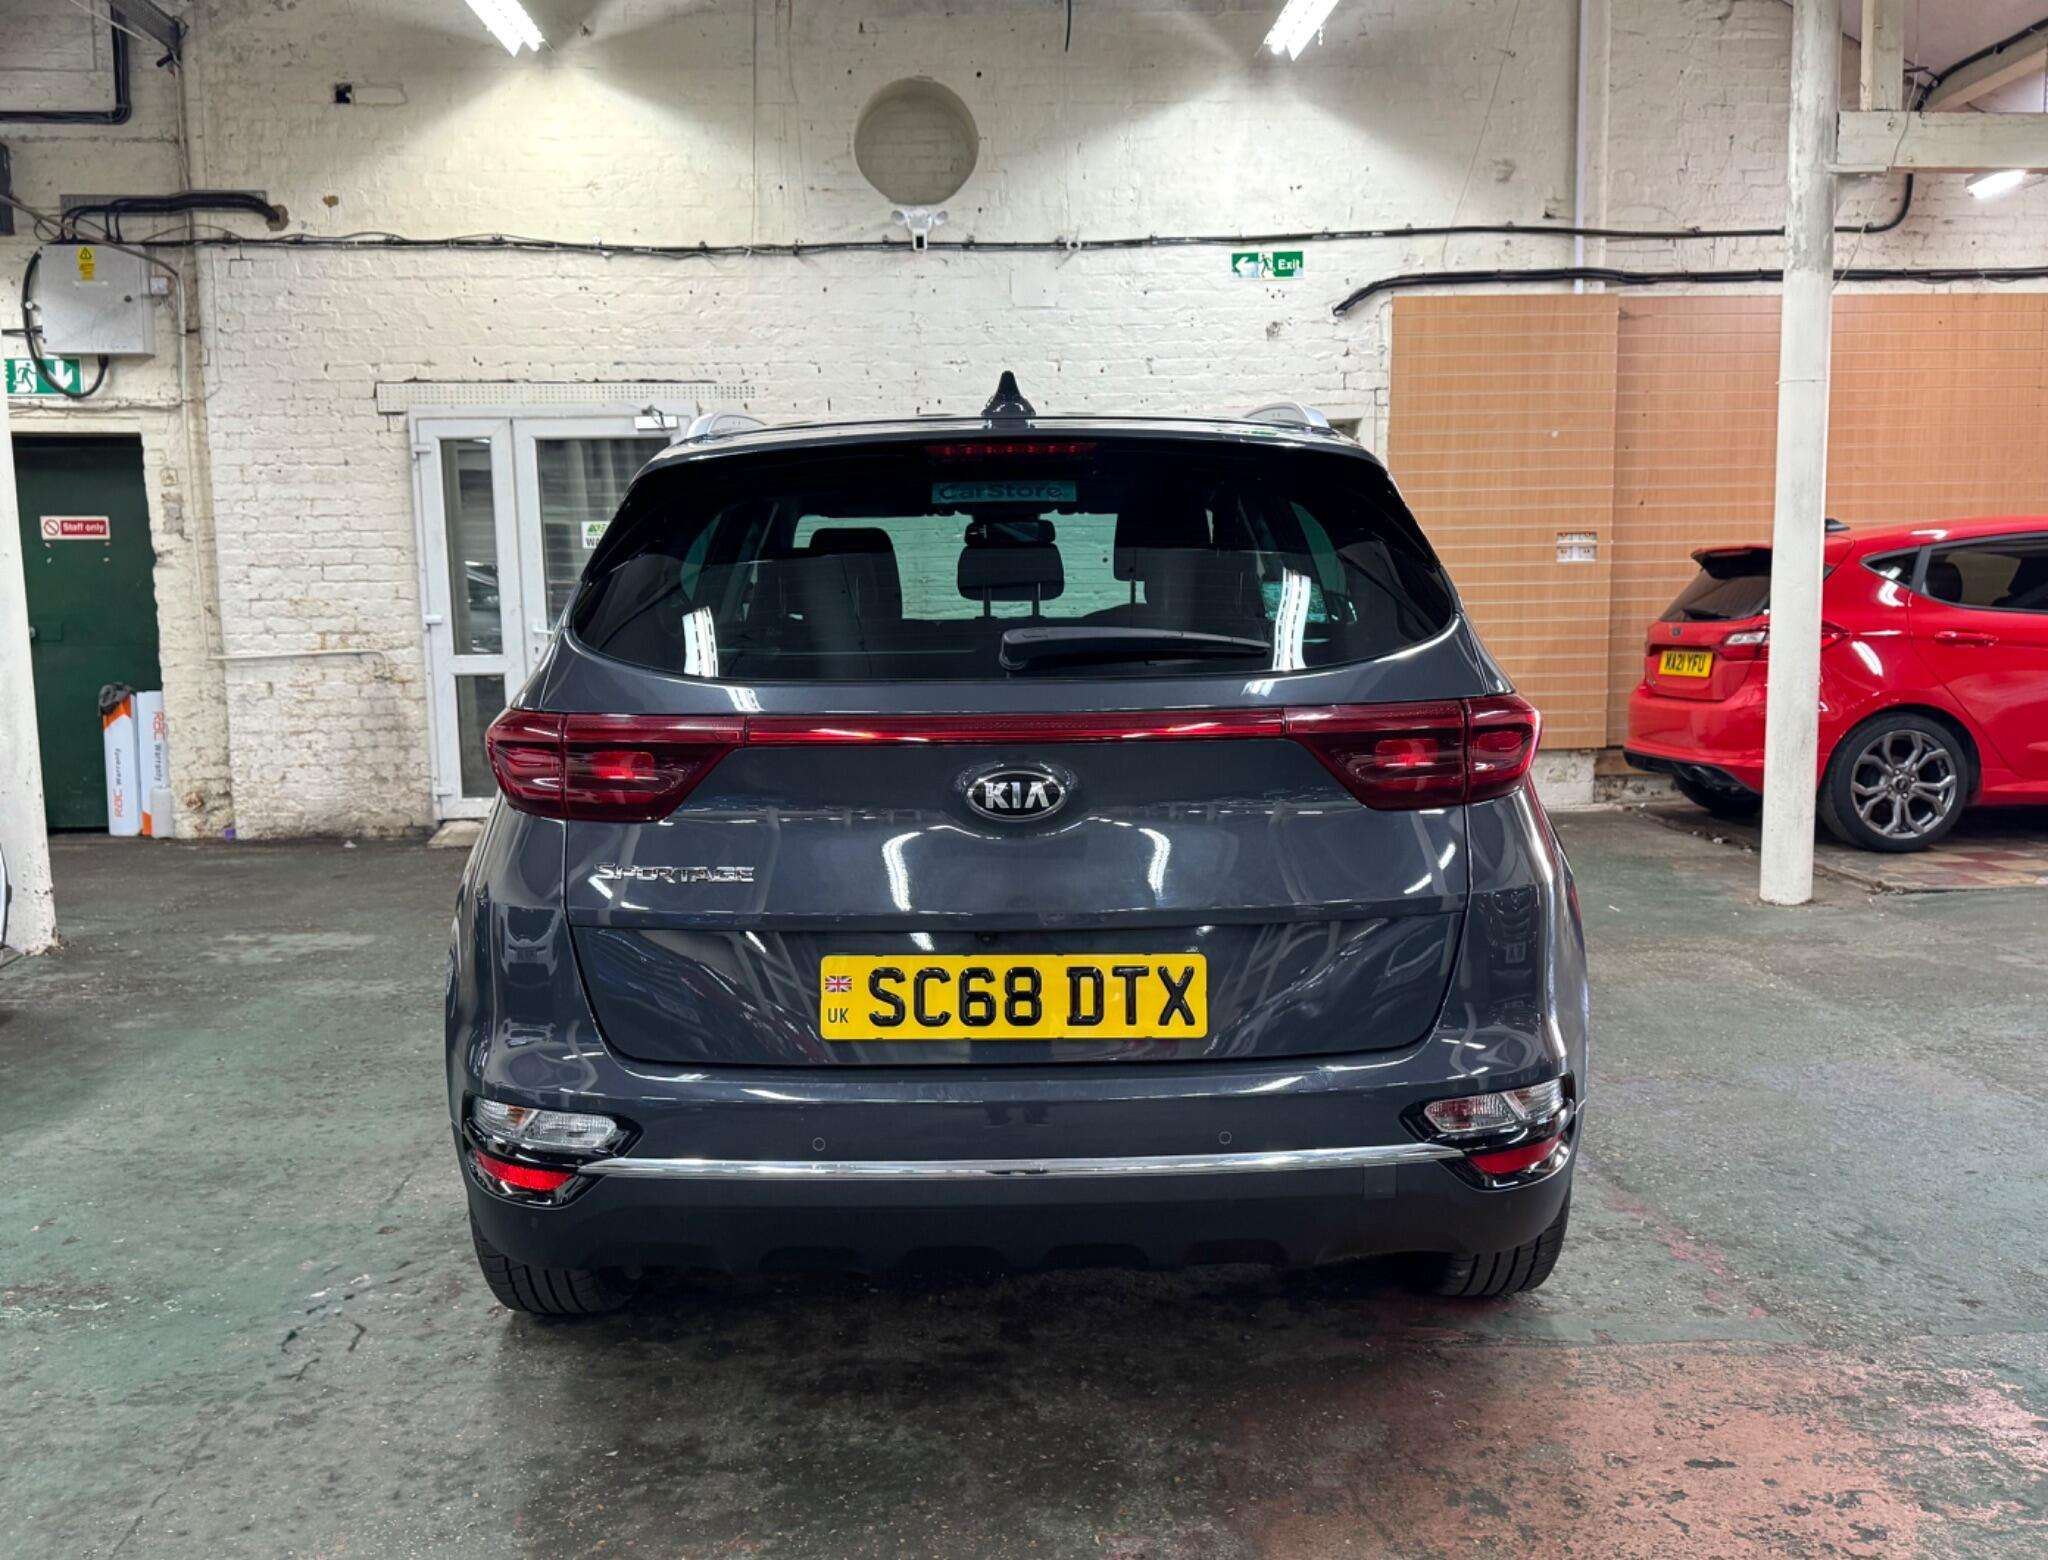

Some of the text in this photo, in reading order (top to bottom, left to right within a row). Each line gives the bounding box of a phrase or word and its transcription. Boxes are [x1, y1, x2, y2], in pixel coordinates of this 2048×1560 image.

[1278, 258, 1300, 270] Exit
[62, 522, 104, 533] Staff only
[114, 748, 122, 785] Warranty
[984, 781, 1050, 808] KIA
[594, 863, 755, 883] SPORTAGE
[868, 965, 1196, 1027] SC68 DTX
[827, 1008, 849, 1024] UK
